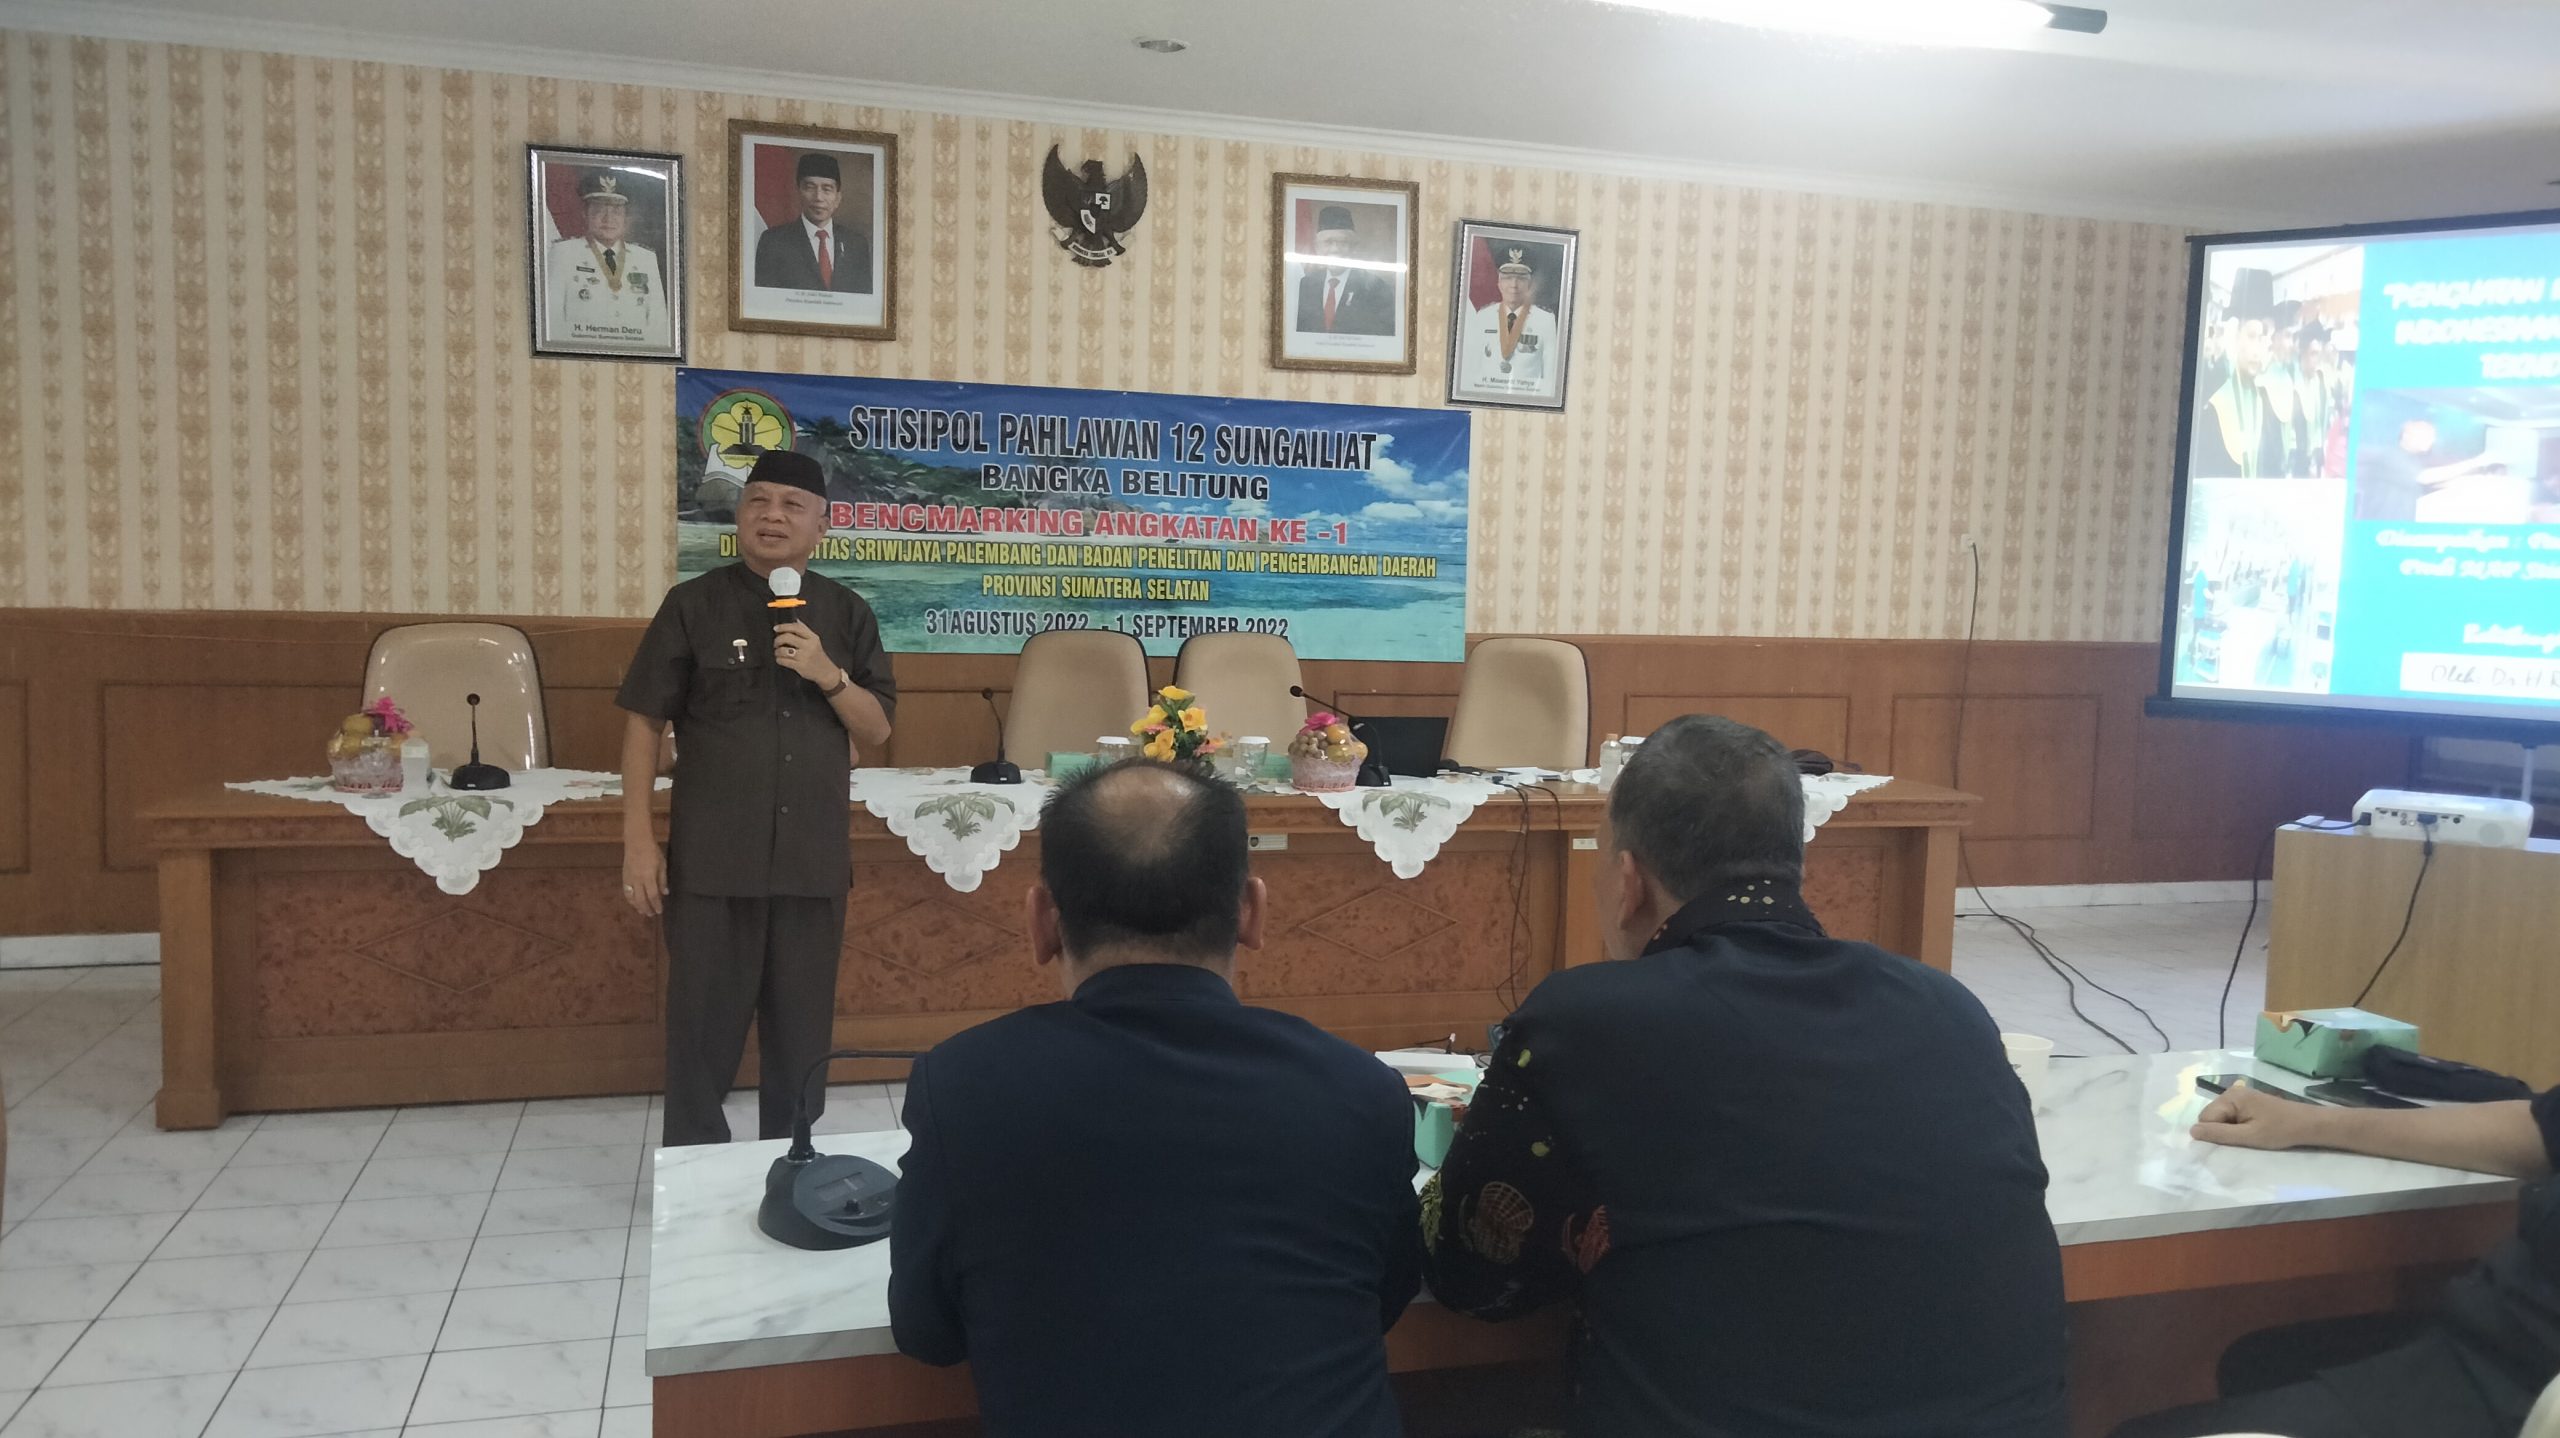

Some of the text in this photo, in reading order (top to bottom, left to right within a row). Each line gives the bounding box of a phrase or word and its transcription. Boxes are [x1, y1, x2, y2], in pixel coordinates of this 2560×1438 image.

[585, 324, 619, 333] Herman
[621, 326, 642, 334] Deru
[849, 404, 1378, 471] STISIPOL PAHLAWAN 12 SUNGAILIAT
[981, 463, 1270, 501] BANGKA BELITUNG
[831, 502, 1084, 537] BENCMARKING
[1094, 511, 1258, 542] ANGKATAN
[1269, 519, 1308, 545] KE
[720, 533, 737, 558] DI
[855, 538, 942, 562] SRIWIJAYA
[946, 540, 1042, 566] PALEMBANG
[1049, 543, 1079, 566] DAN
[1083, 545, 1133, 569] BADAN
[1138, 546, 1222, 571] PENELITIAN
[1226, 550, 1256, 573] DAN
[1260, 551, 1378, 576] PENGEMBANGAN
[1382, 554, 1437, 578] DAERAH
[982, 574, 1210, 601] PROVINSI SUMATERA SELATAN
[1043, 612, 1089, 632] 2022
[1115, 614, 1125, 634] 1
[1132, 613, 1239, 639] SEPTEMBER
[1245, 617, 1289, 640] 2022
